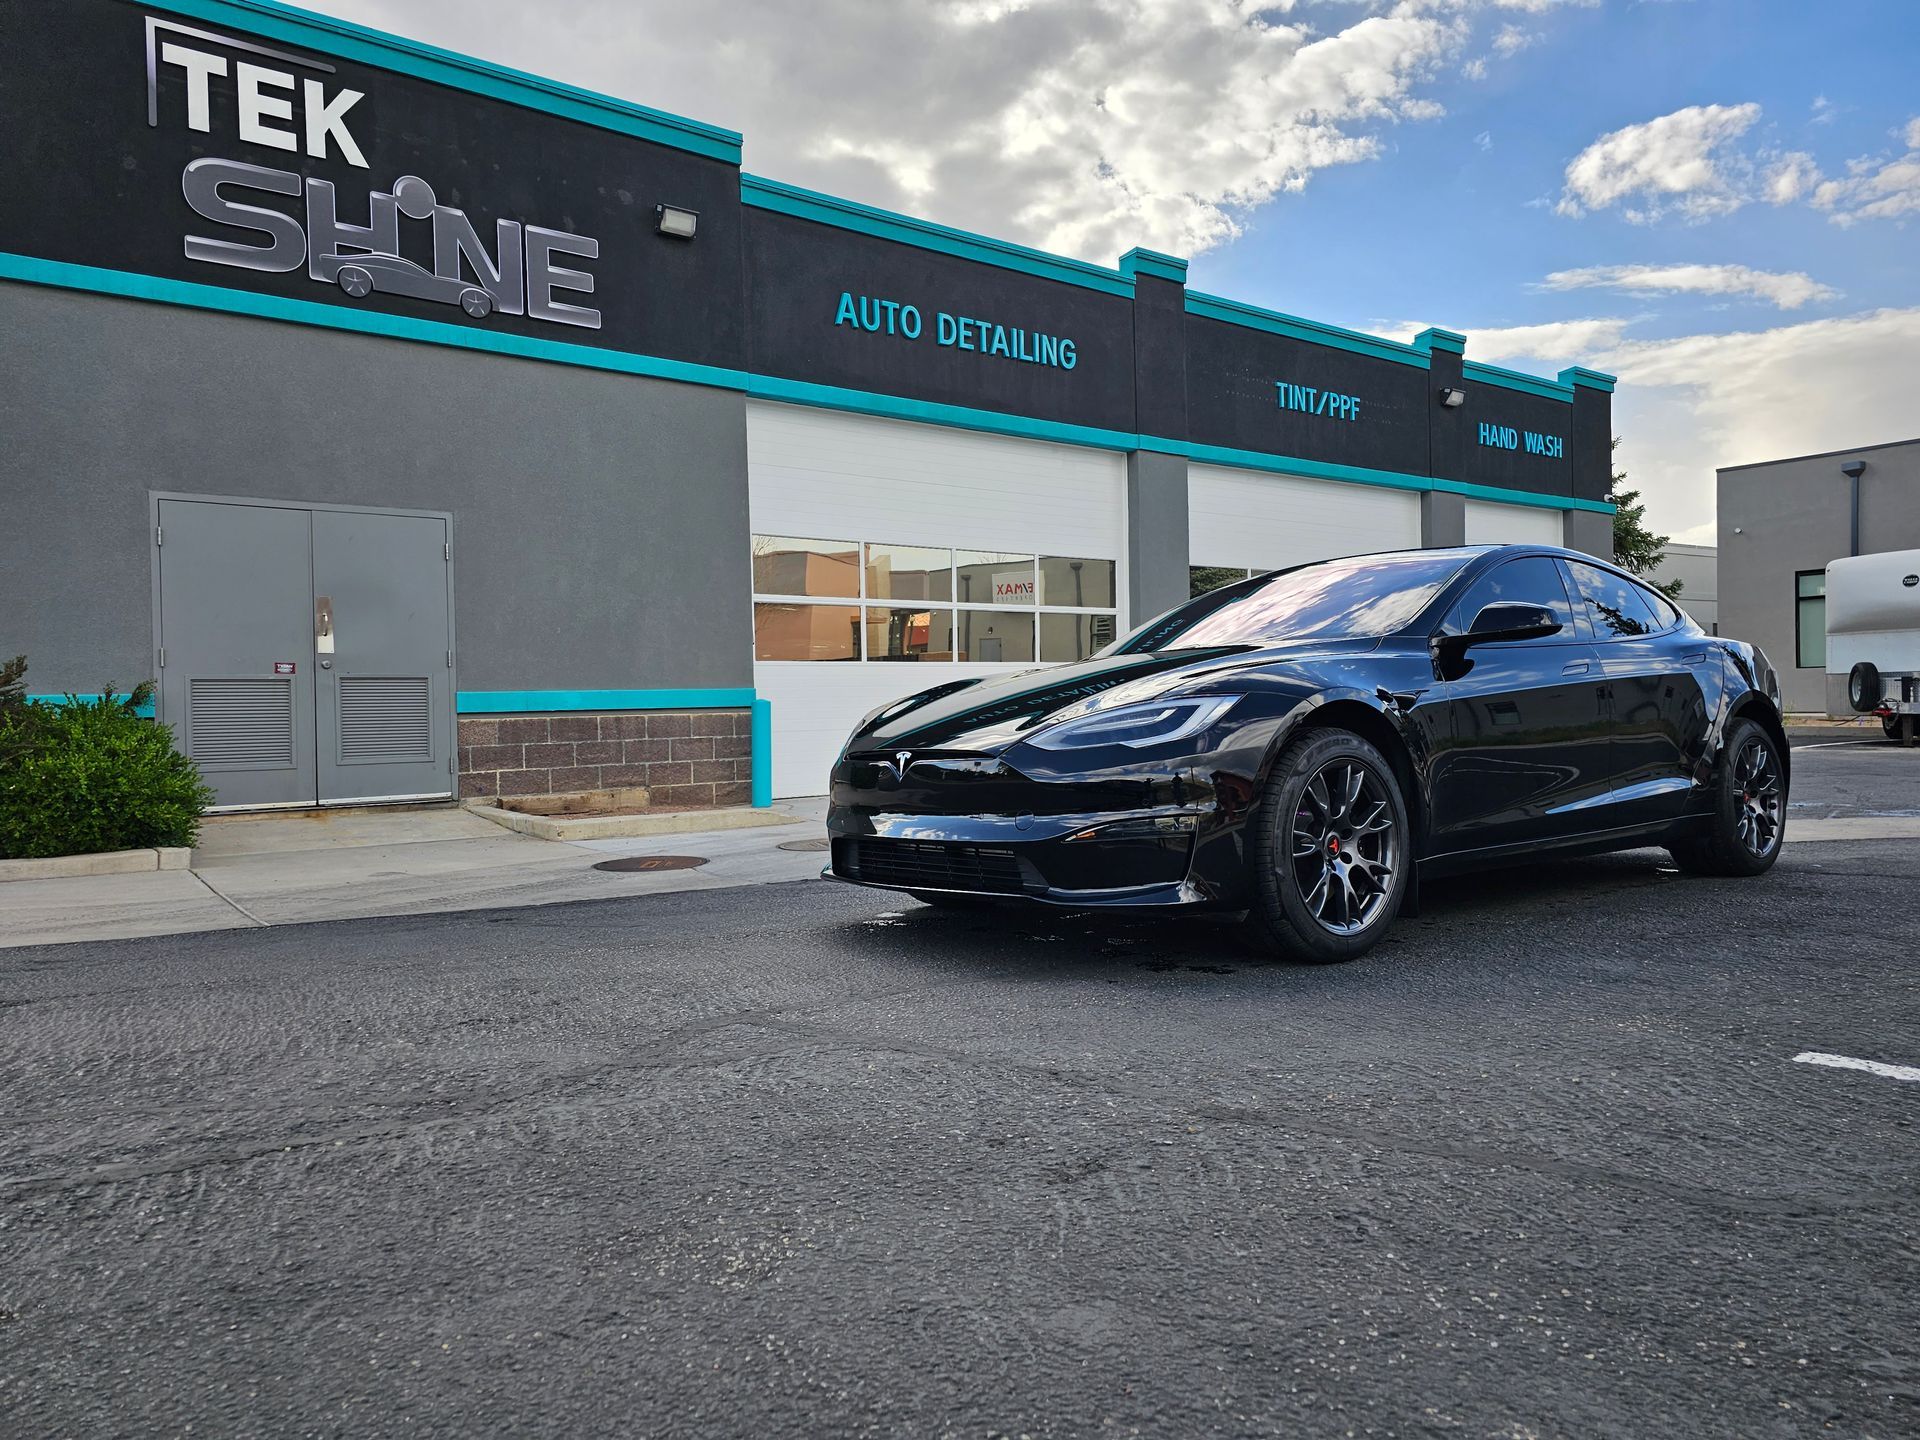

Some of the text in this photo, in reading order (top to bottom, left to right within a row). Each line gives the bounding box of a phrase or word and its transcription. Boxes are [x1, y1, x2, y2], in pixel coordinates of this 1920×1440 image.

[162, 42, 370, 169] TEK
[182, 157, 602, 329] SHINE
[834, 291, 1077, 370] AUTO DETAILING
[1275, 381, 1361, 421] TINT/PPF
[1478, 422, 1563, 458] HAND WASH
